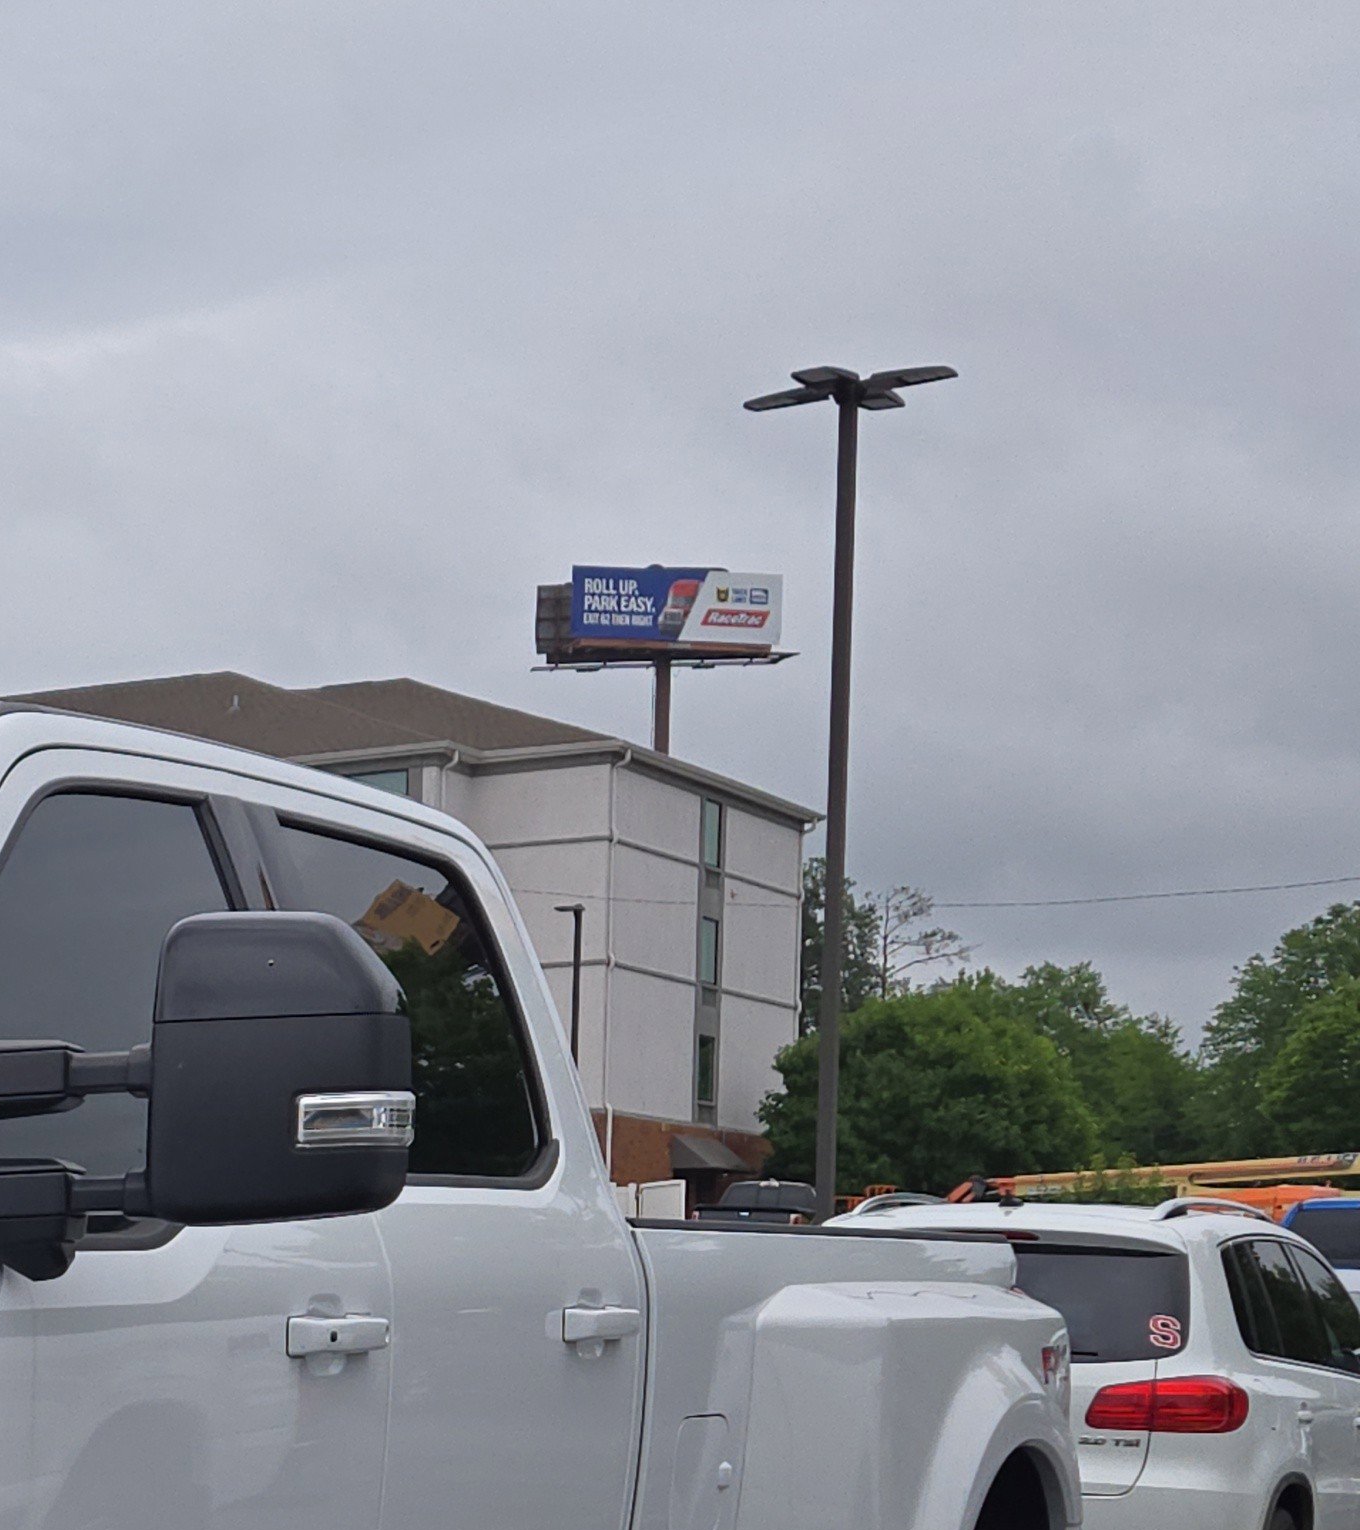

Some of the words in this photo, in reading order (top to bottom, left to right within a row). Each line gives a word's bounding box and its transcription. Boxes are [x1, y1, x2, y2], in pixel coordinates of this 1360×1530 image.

[584, 578, 617, 594] ROLL
[584, 595, 618, 611] PARK
[620, 596, 656, 613] EASY.
[708, 611, 763, 627] RaceTrac
[1150, 1314, 1181, 1349] S
